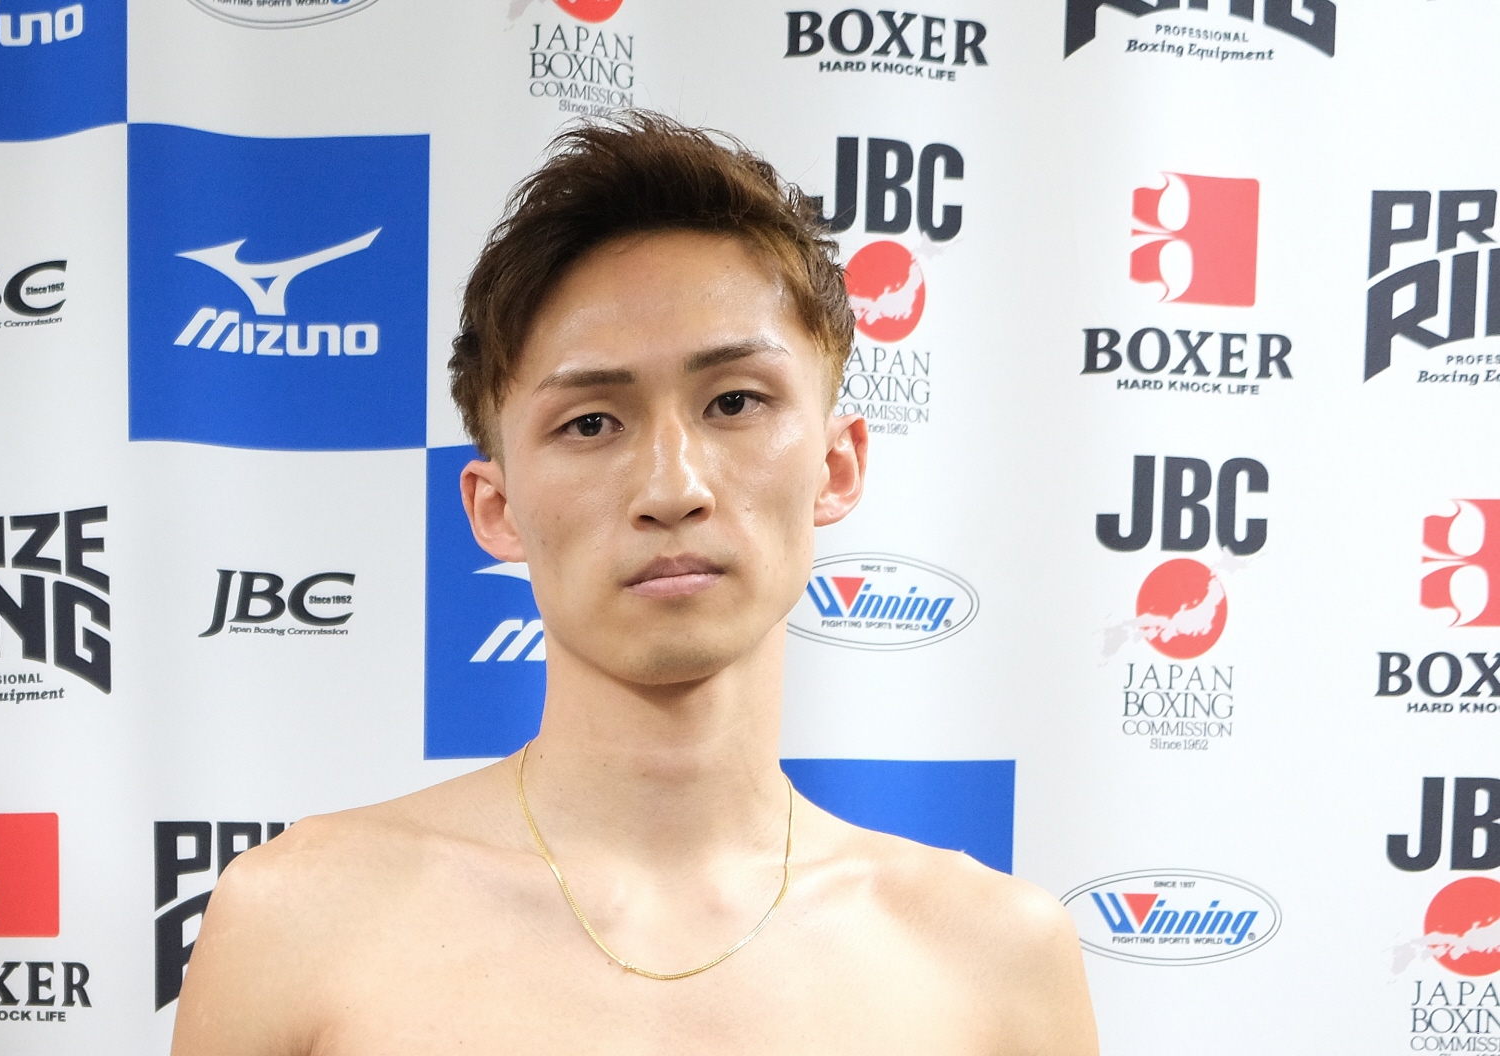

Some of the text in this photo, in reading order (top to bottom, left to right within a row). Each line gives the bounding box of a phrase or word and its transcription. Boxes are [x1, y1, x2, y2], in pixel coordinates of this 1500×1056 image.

[530, 23, 634, 62] JAPAN
[783, 8, 989, 67] BOXER
[1155, 24, 1249, 43] PROFESSIONAL
[1125, 39, 1275, 62] Boxing Equipment
[529, 51, 634, 89] BOXING
[819, 61, 956, 82] HARD KNOCK LIFE
[529, 80, 634, 107] COMMISSION
[812, 136, 965, 242] JBC
[4, 318, 62, 329] Commission
[174, 307, 379, 357] MIZUNO
[1079, 327, 1293, 380] BOXER
[1117, 379, 1260, 396] HARD KNOCK LIFE
[1417, 369, 1480, 386] Boxing
[1095, 455, 1269, 556] JBC
[198, 569, 356, 637] JBC
[806, 576, 955, 631] Winning
[228, 625, 348, 636] Japan Boxing Commission
[821, 620, 861, 628] FIGHTING
[865, 621, 892, 630] SPORTS
[1124, 663, 1234, 691] JAPAN
[1374, 651, 1500, 698] BOX
[1122, 691, 1234, 719] BOXING
[1407, 702, 1454, 713] HARD
[1122, 720, 1233, 737] COMMISSION
[1150, 738, 1208, 751] Since 1952
[1090, 892, 1259, 945] Winning
[1112, 936, 1223, 945] FIGHTING SPORTS WORLD
[36, 1010, 67, 1022] LIFE
